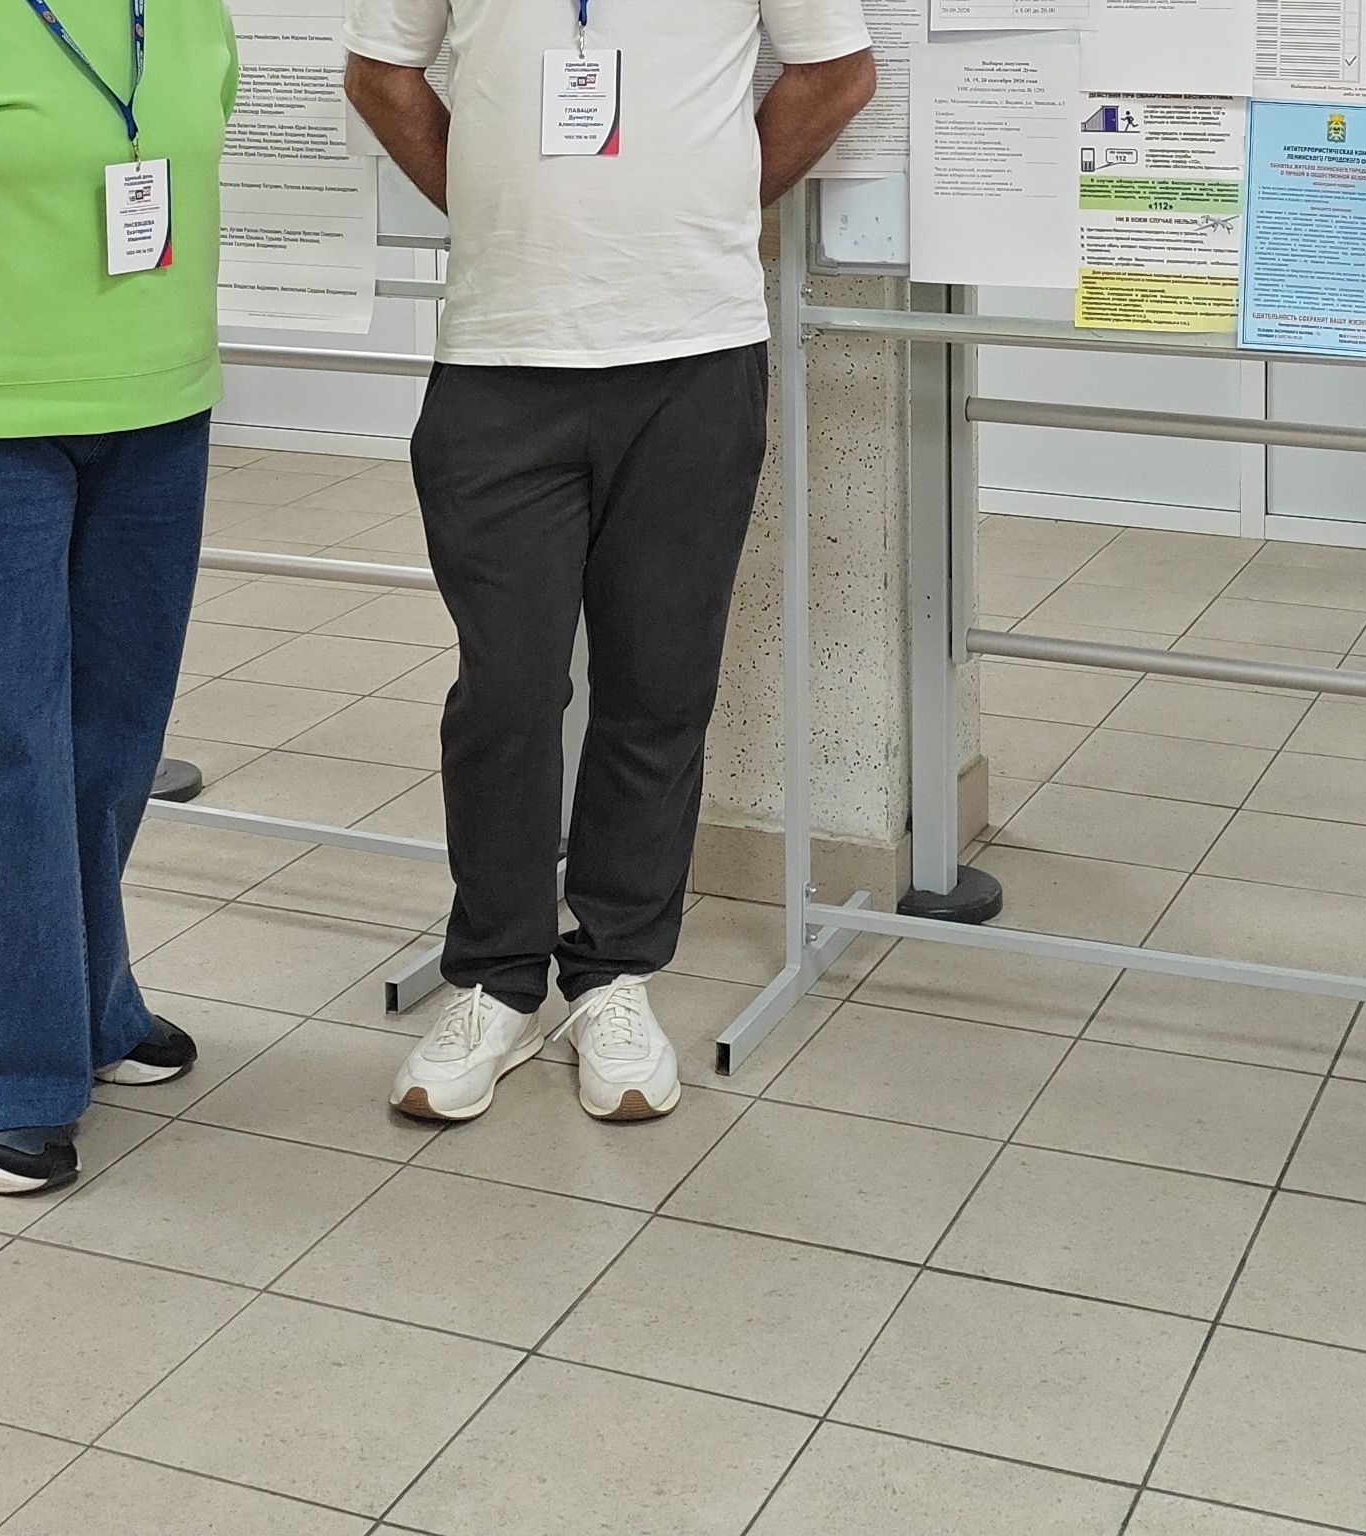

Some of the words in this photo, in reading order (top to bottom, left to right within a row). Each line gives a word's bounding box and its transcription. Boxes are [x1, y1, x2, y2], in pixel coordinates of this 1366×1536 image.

[1283, 145, 1353, 156] АНТИТЕРРОРИСТИЧЕСКАЯ
[1287, 153, 1323, 162] ЛЕНИНСКОГО
[1325, 156, 1360, 164] ГОРОДСКОГО
[1148, 202, 1173, 210] «112»
[1330, 317, 1346, 325] ВАШУ
